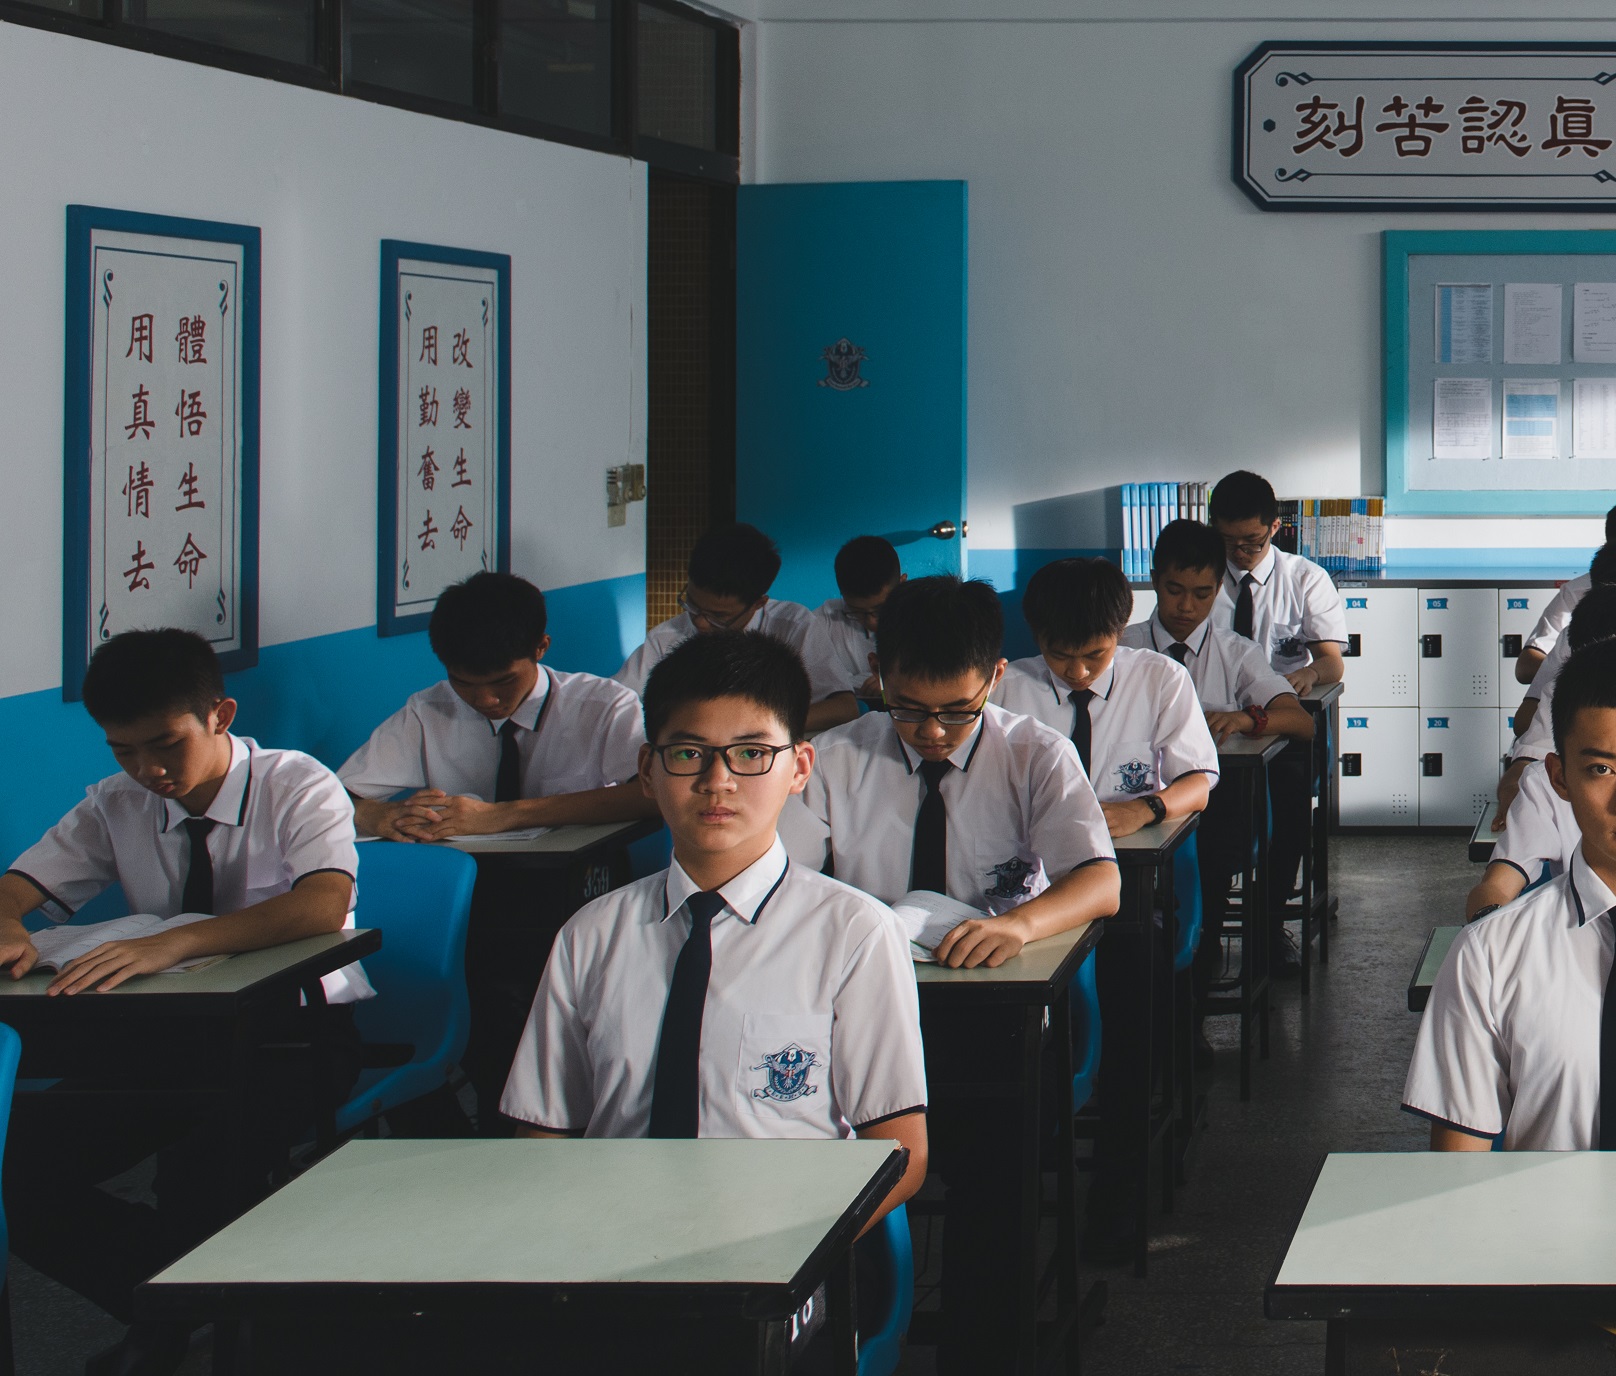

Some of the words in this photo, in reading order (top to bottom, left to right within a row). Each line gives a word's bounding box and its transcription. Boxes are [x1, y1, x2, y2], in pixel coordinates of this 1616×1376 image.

[122, 314, 156, 592] 用真情去
[174, 315, 208, 590] 體悟生命
[417, 326, 439, 551] 用勤奮去
[451, 329, 473, 552] 改變生命
